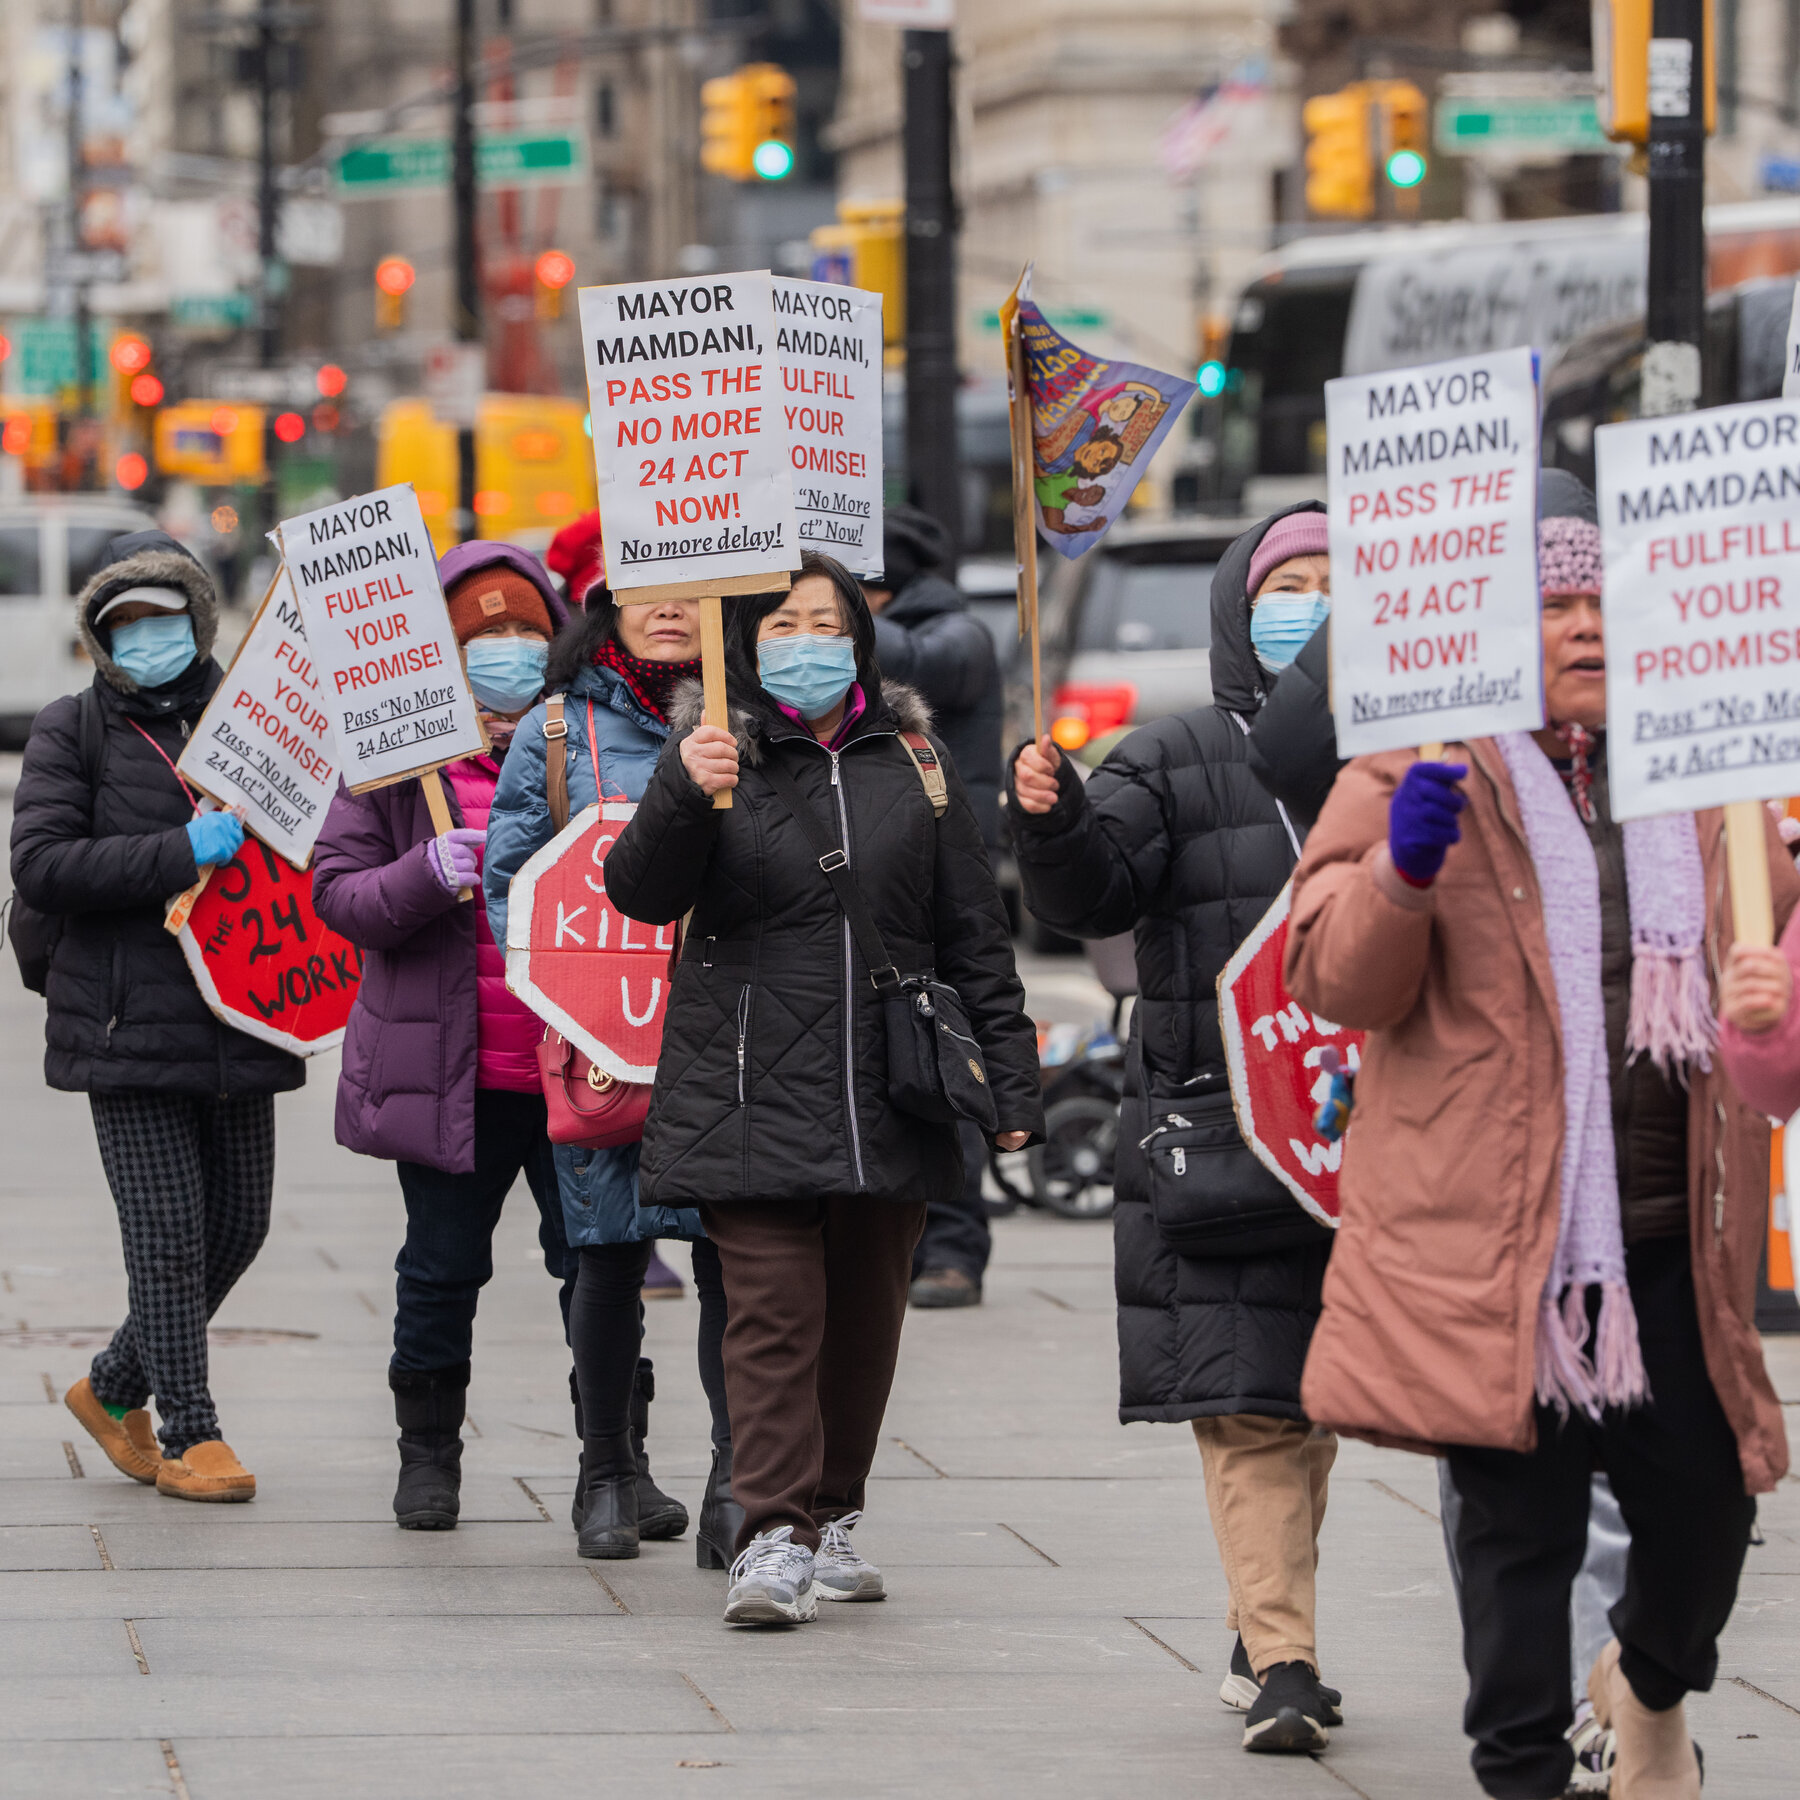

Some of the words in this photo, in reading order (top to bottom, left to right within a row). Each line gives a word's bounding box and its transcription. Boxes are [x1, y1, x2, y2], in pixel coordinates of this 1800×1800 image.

[617, 285, 734, 322] MAYOR
[773, 288, 853, 323] MAYOR
[597, 324, 763, 366] MAMDANI,
[1036, 348, 1081, 379] OCT
[607, 372, 692, 407] PASS
[701, 365, 762, 397] THE
[780, 366, 855, 400] ULFILL
[1368, 369, 1491, 420] MAYOR
[617, 417, 662, 447] NO
[672, 406, 762, 442] MORE
[784, 404, 844, 437] YOUR
[1649, 413, 1797, 466] MAYOR
[639, 458, 675, 487] 24
[684, 450, 749, 482] ACT
[1343, 418, 1519, 476] MAMDANI,
[655, 492, 741, 527] NOW!
[799, 488, 829, 509] “No
[832, 492, 870, 515] More
[1349, 482, 1436, 525] PASS
[1450, 468, 1515, 509] THE
[309, 499, 392, 546] MAYOR
[621, 539, 652, 561] No
[658, 535, 712, 557] more
[717, 523, 782, 550] delay!
[825, 520, 864, 543] Now!
[300, 532, 419, 587] MAMDANI,
[1355, 539, 1399, 577] NO
[1409, 521, 1508, 568] MORE
[1648, 520, 1800, 573] FULFILL
[325, 573, 414, 619] FULFILL
[1373, 592, 1409, 625] 24
[1420, 576, 1491, 619] ACT
[1672, 577, 1781, 622] YOUR
[345, 613, 410, 651] YOUR
[1388, 631, 1478, 674] NOW!
[333, 641, 443, 695] PROMISE!
[1635, 628, 1800, 685] PROMIS
[275, 677, 328, 739] YOUR
[343, 707, 379, 731] Pass
[380, 696, 411, 721] “No
[415, 684, 455, 710] More
[1353, 694, 1380, 720] No
[1387, 685, 1443, 714] more
[1450, 669, 1522, 707] delay!
[233, 690, 332, 786] PROMISE!
[357, 739, 375, 757] 24
[377, 725, 409, 752] Act”
[414, 710, 455, 737] Now!
[1635, 711, 1695, 741] Pass
[1701, 696, 1755, 730] “No
[215, 721, 253, 757] Pass
[257, 750, 280, 781] “No
[280, 776, 317, 815] More
[1649, 753, 1677, 781] 24
[1684, 737, 1742, 774] Act”
[207, 751, 229, 772] 24
[229, 766, 265, 792] Act”
[261, 791, 301, 831] Now!
[204, 912, 235, 956] THE
[242, 893, 308, 965] 24
[248, 945, 365, 1019] WORK
